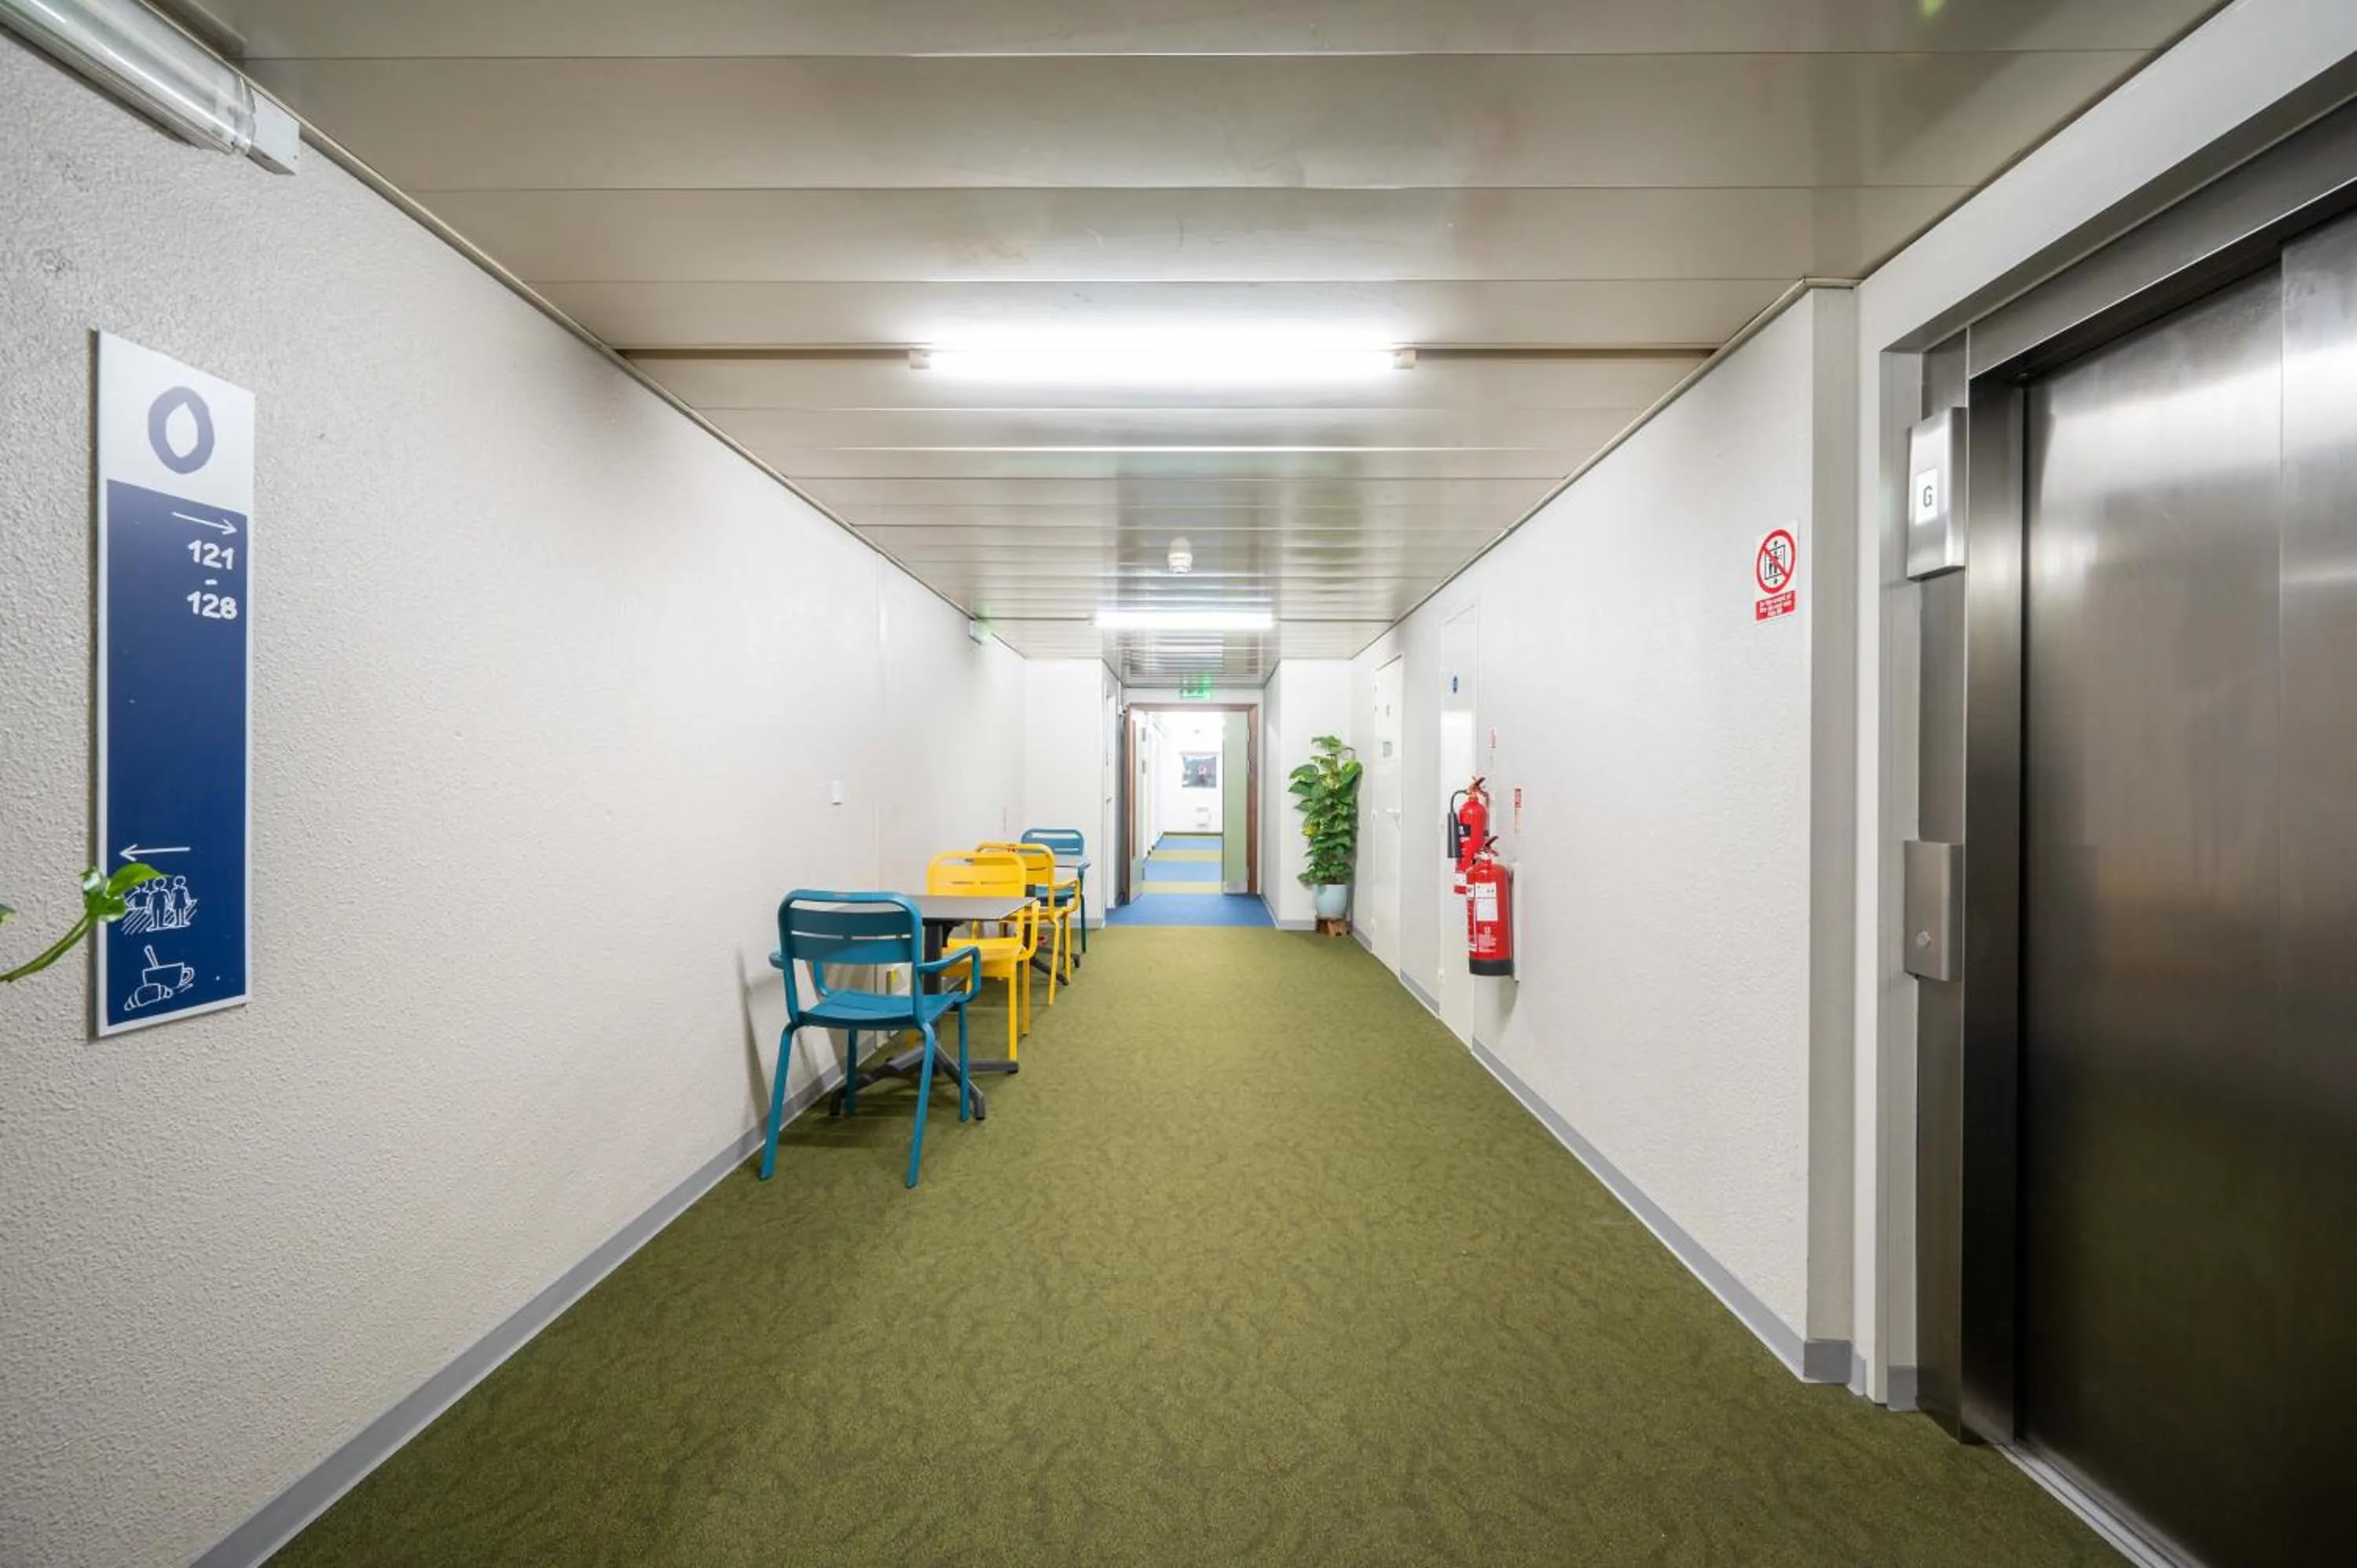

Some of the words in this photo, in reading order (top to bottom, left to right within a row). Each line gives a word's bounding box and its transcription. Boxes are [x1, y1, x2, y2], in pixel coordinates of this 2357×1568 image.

[1923, 485, 1932, 507] G
[188, 540, 234, 570] 121
[187, 591, 237, 620] 128
